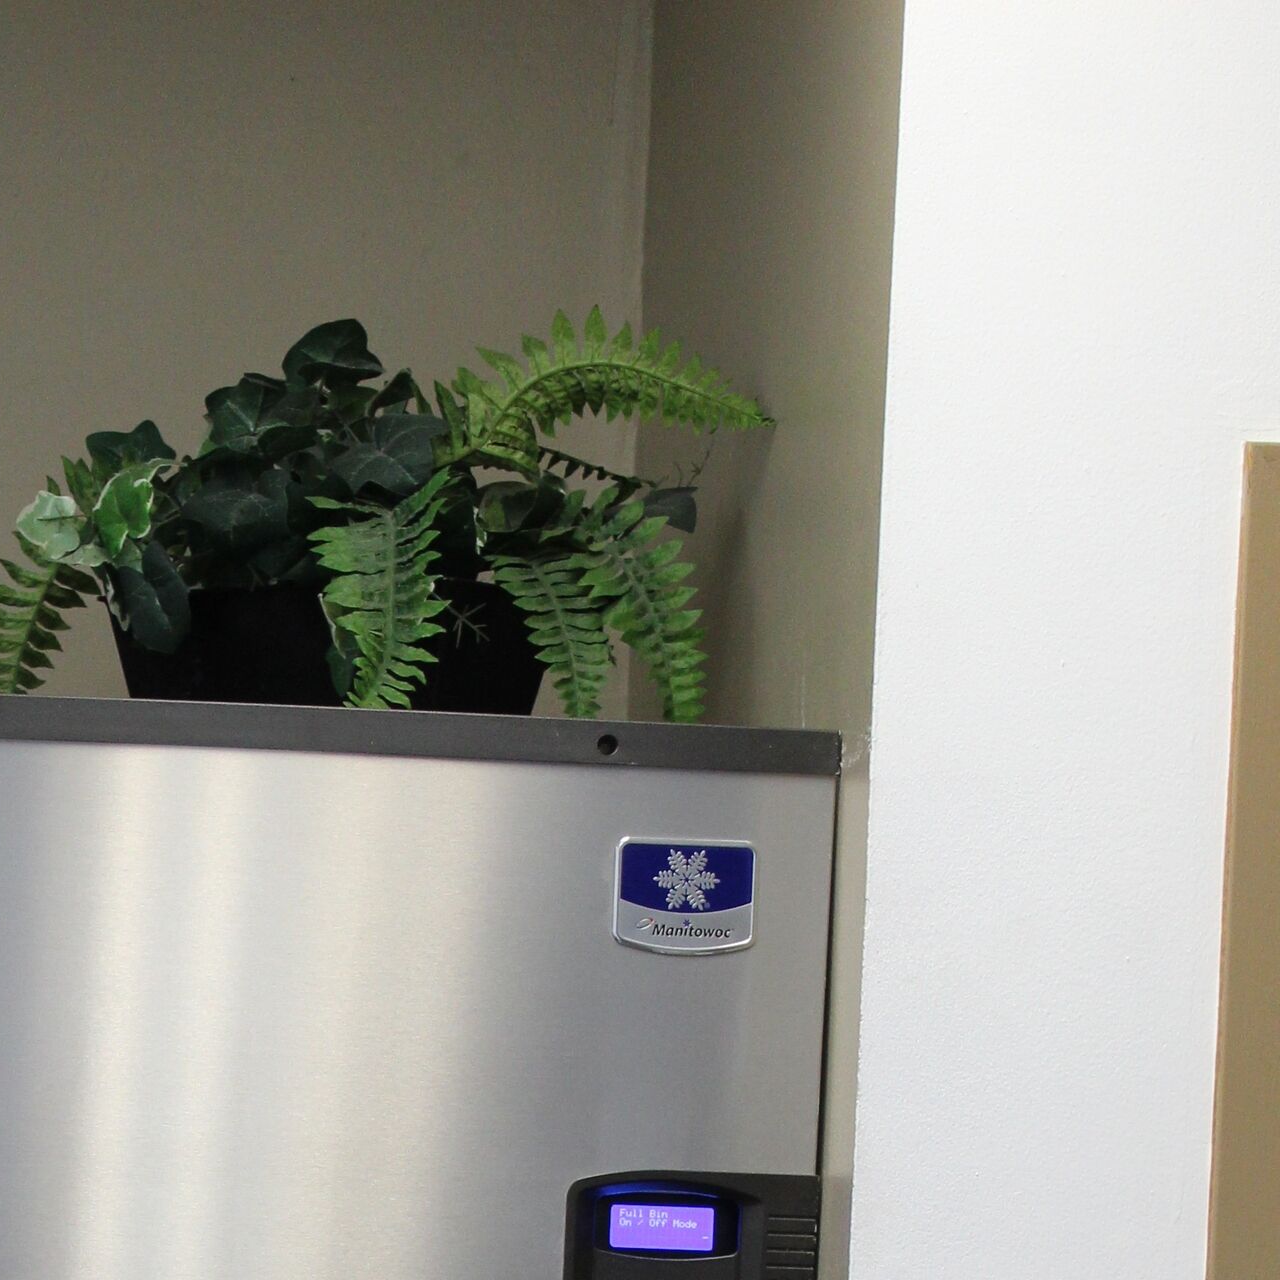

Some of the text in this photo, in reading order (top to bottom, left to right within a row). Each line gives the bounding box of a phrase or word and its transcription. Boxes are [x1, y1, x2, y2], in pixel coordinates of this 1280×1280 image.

[651, 922, 731, 938] Manitowoc
[619, 1208, 669, 1219] Full Bin
[619, 1218, 632, 1227] On
[648, 1219, 668, 1228] Off
[672, 1220, 698, 1229] Mode
